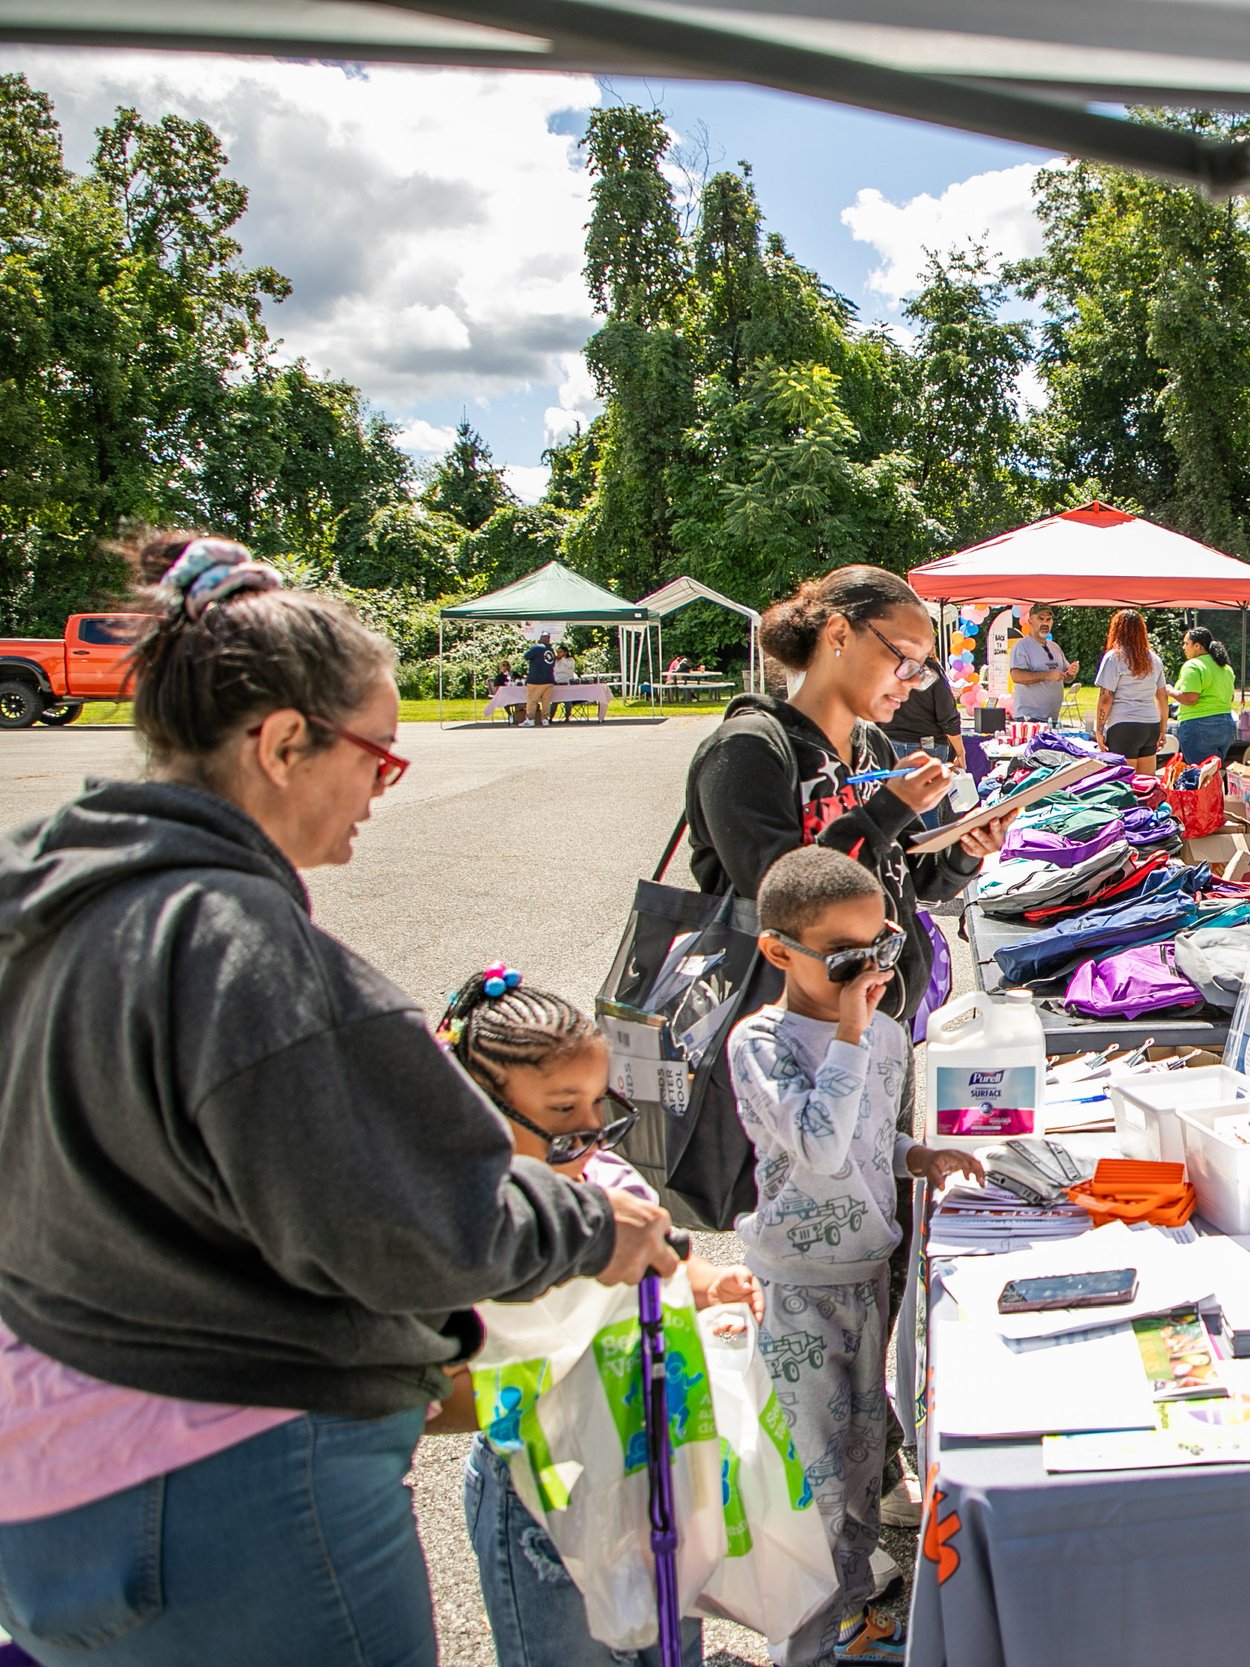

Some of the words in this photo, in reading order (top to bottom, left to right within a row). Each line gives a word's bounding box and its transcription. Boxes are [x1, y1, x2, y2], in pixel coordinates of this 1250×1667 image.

[666, 1069, 678, 1114] AFTER
[972, 1072, 1002, 1083] Purell
[675, 1069, 686, 1115] HOOL
[970, 1089, 1002, 1098] SURFACE
